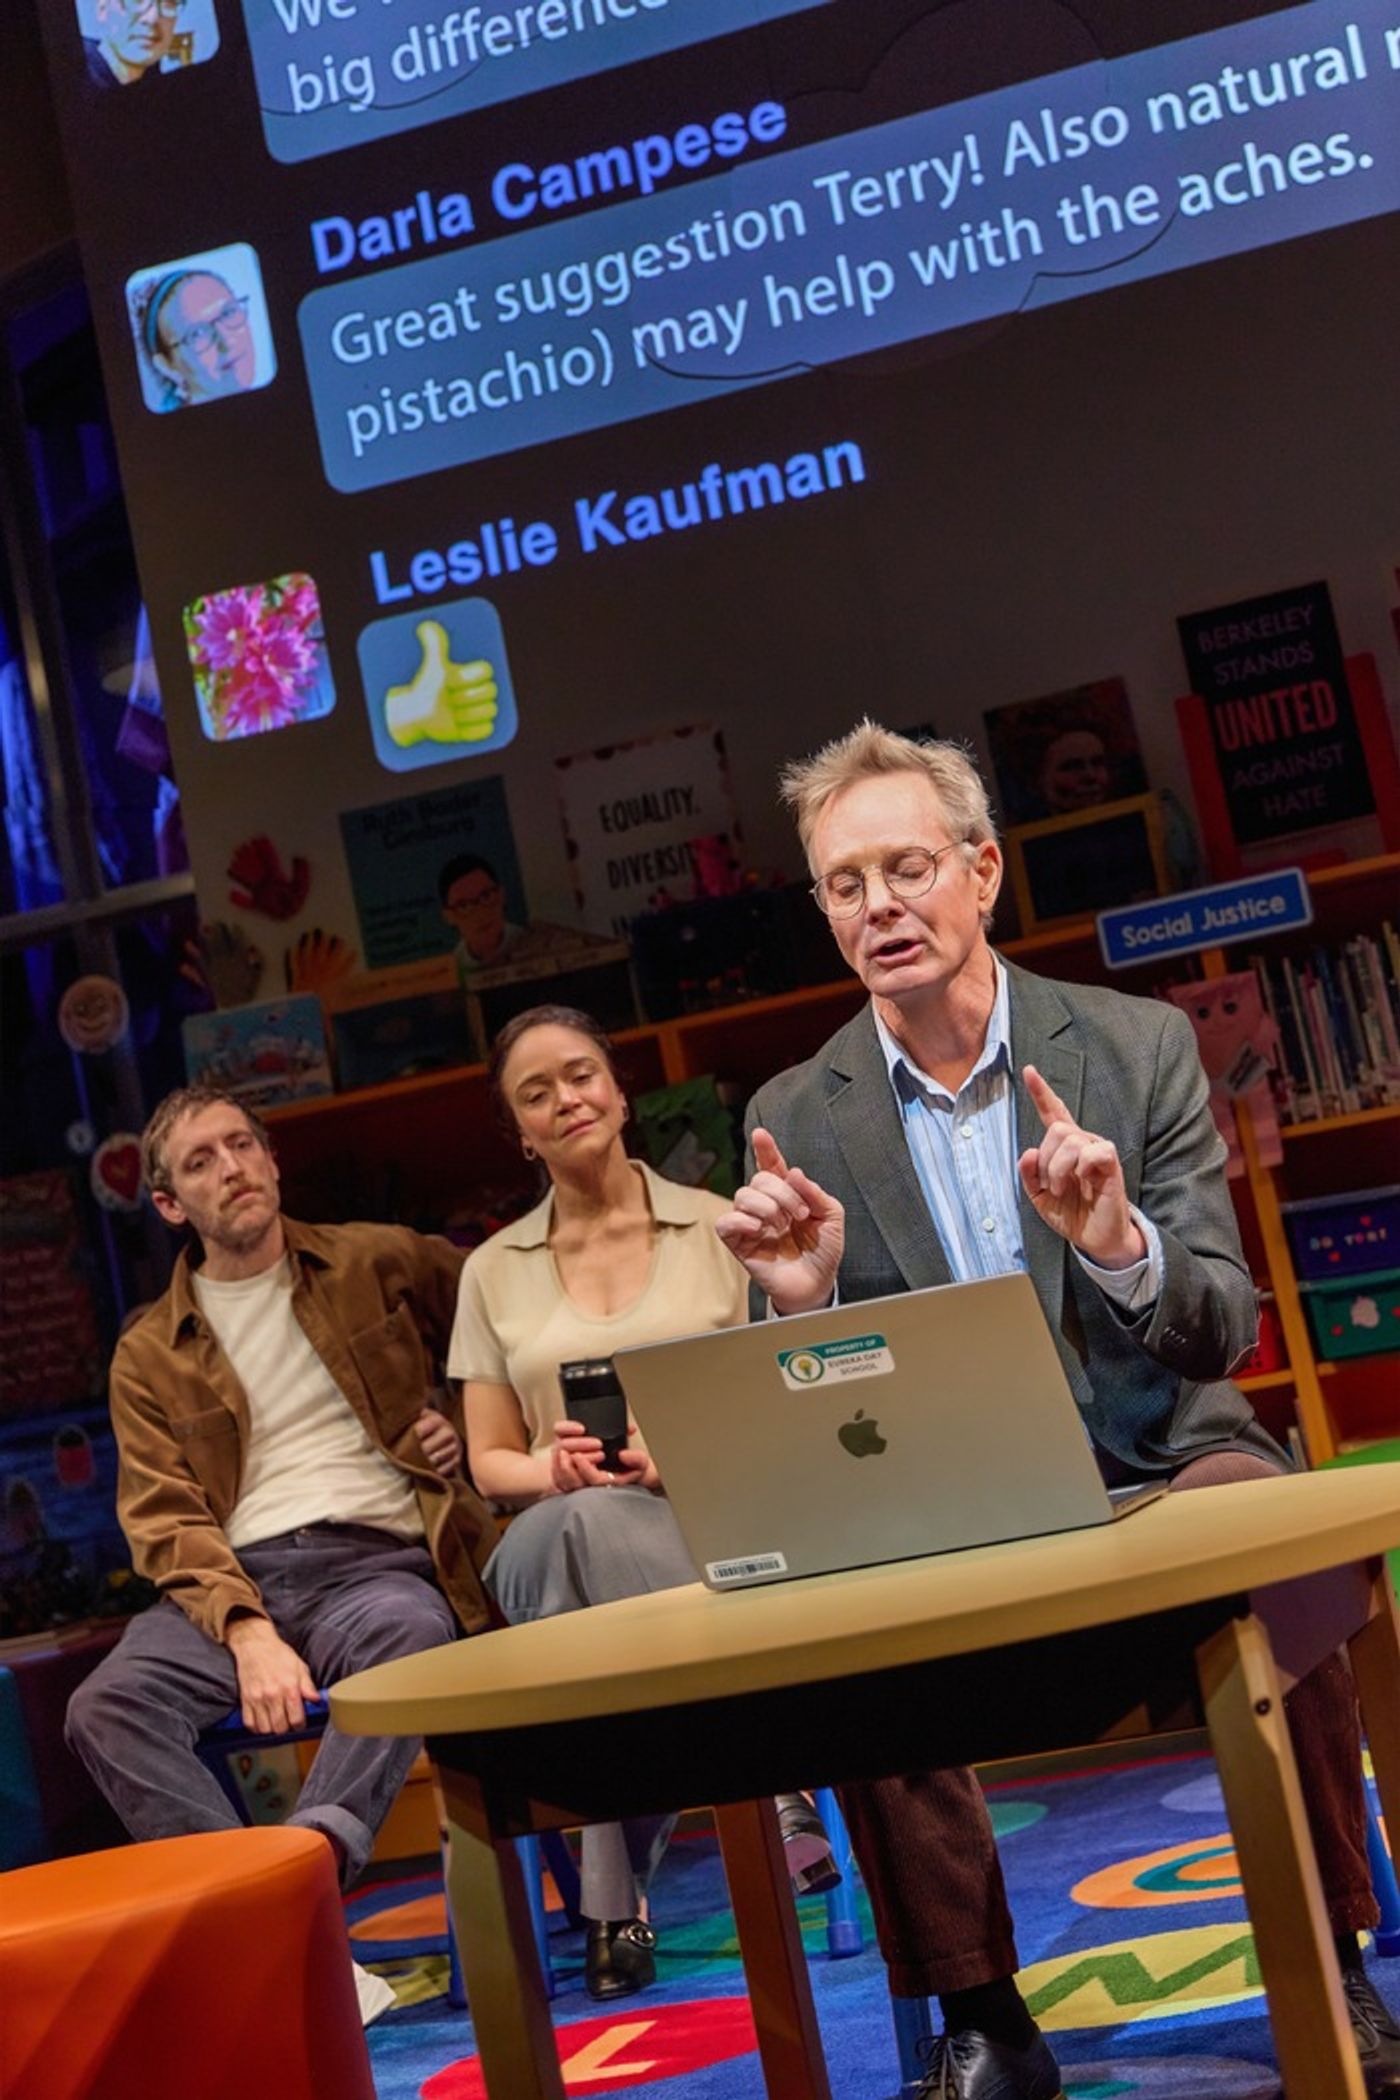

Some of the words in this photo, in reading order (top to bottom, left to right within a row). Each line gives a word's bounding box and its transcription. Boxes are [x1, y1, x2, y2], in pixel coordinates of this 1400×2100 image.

[287, 55, 375, 112] big
[391, 0, 669, 81] differen
[311, 191, 475, 272] Darla
[492, 100, 787, 220] Campese
[331, 289, 481, 364] Great
[496, 199, 807, 322] suggestion
[813, 134, 985, 226] Terry!
[1002, 107, 1128, 177] Also
[1147, 24, 1367, 133] natural
[348, 328, 613, 456] pistachio)
[633, 298, 747, 368] may
[764, 254, 894, 328] help
[909, 208, 1043, 287] with
[1056, 184, 1160, 246] the
[1178, 131, 1373, 217] aches.
[370, 519, 557, 604] Leslie
[575, 439, 866, 553] Kaufman
[1196, 604, 1313, 655] BERKELEY
[1214, 641, 1314, 686] STANDS
[1215, 679, 1338, 752] UNITED
[1231, 743, 1345, 791] AGAINST
[1261, 785, 1327, 819] HATE
[607, 842, 695, 889] DIVERSIT
[1122, 913, 1193, 948] Social
[1202, 893, 1286, 933] Justice
